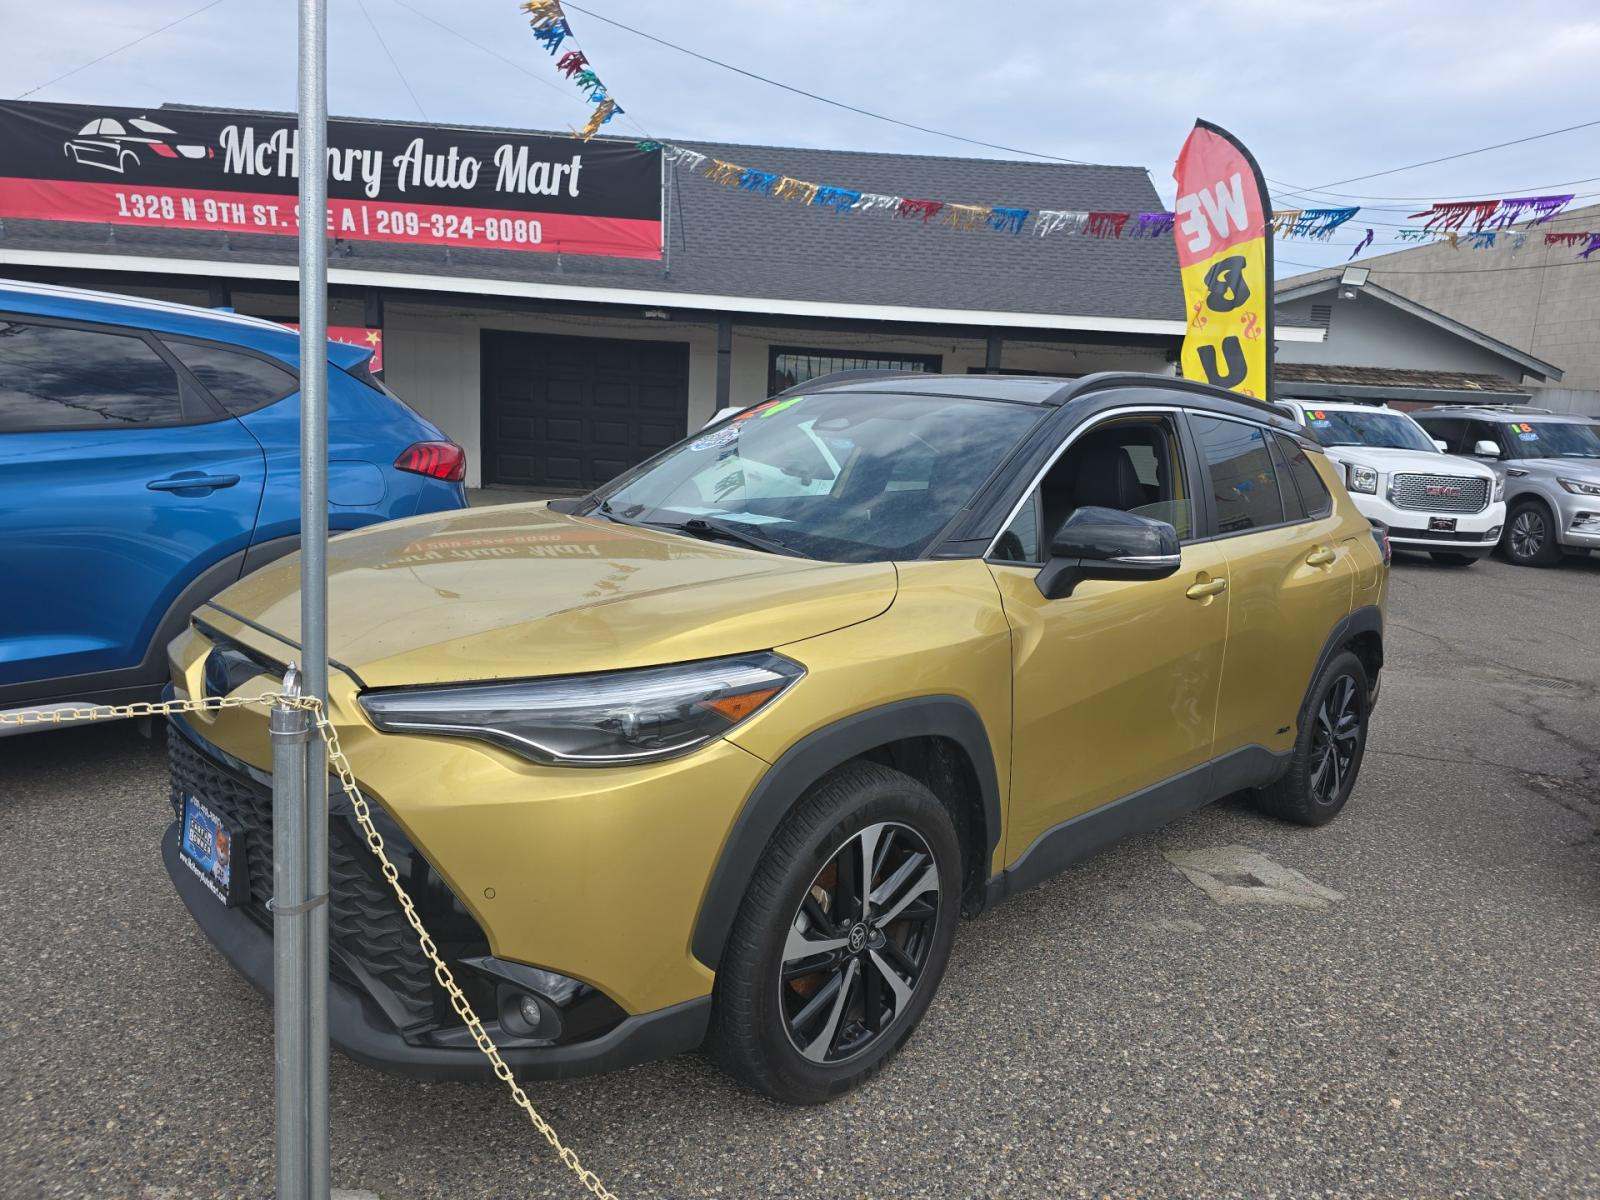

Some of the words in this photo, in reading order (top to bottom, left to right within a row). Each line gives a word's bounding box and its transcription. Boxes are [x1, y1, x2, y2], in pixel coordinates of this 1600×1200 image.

[219, 125, 383, 198] McHnry
[392, 138, 482, 192] Auto
[494, 144, 582, 198] Mart
[115, 193, 175, 220] 1328
[181, 197, 197, 221] N
[203, 198, 246, 225] 9TH
[252, 204, 288, 227] ST.
[341, 208, 356, 232] A
[376, 209, 543, 244] 209-324-8080
